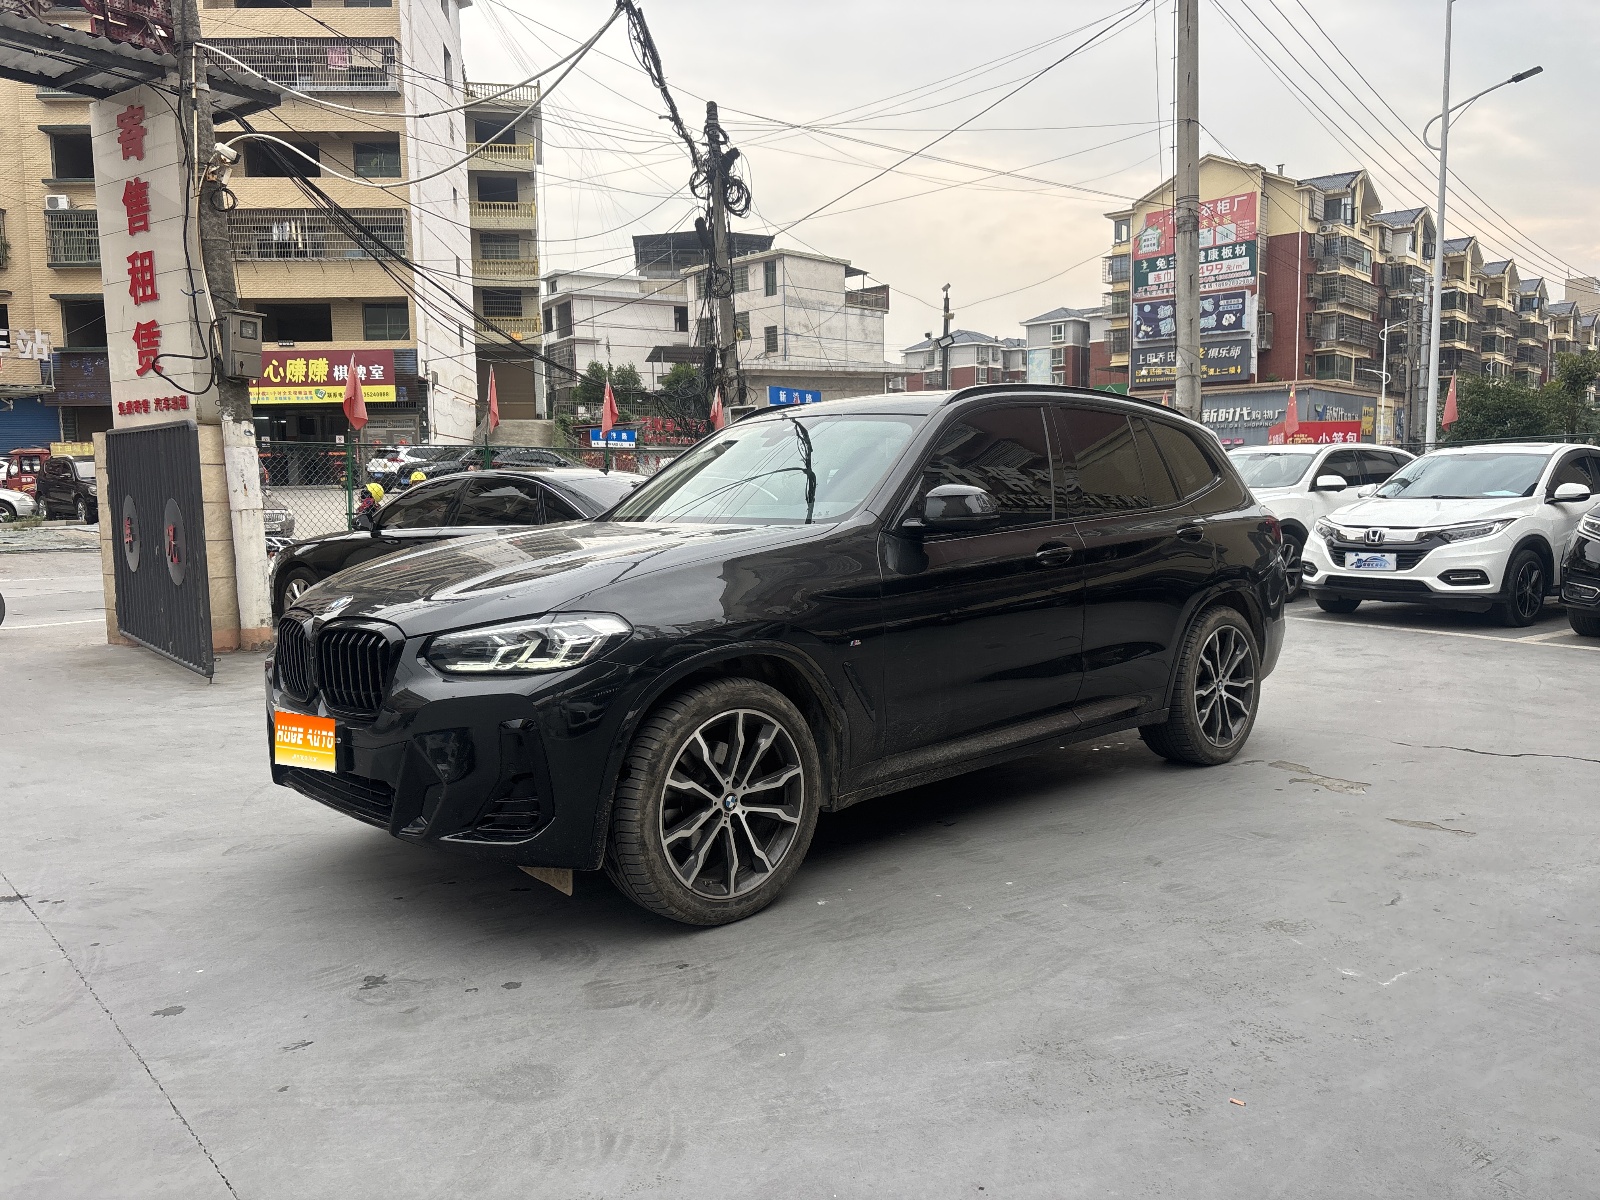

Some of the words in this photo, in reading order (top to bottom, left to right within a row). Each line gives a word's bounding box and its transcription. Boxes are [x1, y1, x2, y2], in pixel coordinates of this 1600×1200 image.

[1200, 196, 1248, 216] 衣柜厂
[117, 105, 163, 377] 寄售租赁
[1208, 346, 1242, 359] 俱乐部
[252, 358, 329, 385] 心赚赚
[1202, 407, 1252, 423] 新时代
[1317, 432, 1357, 443] 小笼包
